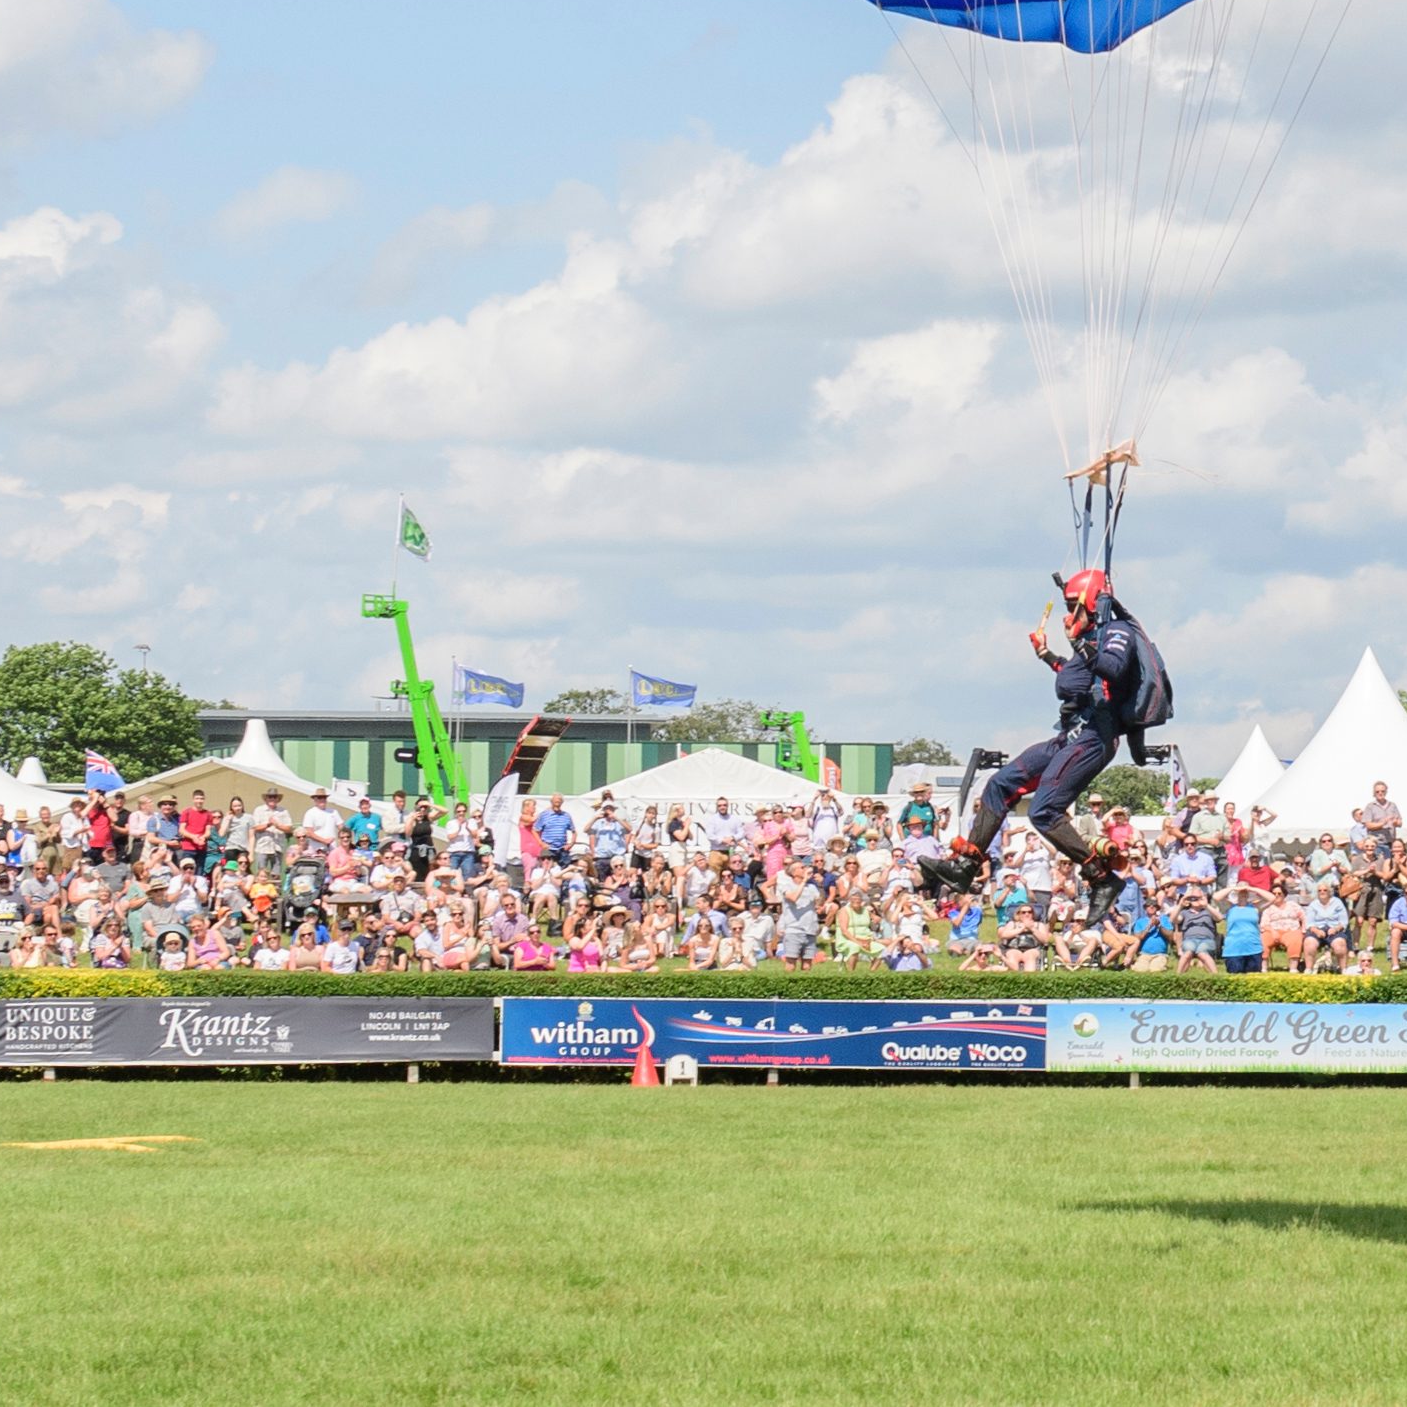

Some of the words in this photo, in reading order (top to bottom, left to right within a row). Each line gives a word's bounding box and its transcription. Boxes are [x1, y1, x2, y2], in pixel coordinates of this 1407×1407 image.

[398, 1010, 442, 1020] BAILGATE
[5, 1026, 94, 1041] BESPOKE
[159, 1008, 273, 1057] Krantz
[360, 1022, 401, 1031] LINCOLN
[531, 1021, 638, 1045] witham
[1130, 1009, 1280, 1045] Emerald
[1285, 1009, 1391, 1056] Green
[192, 1036, 271, 1046] DESIGNS
[558, 1047, 612, 1056] GROUP
[1131, 1047, 1158, 1060] High
[1160, 1047, 1202, 1060] Quality
[1205, 1046, 1237, 1058] Dried
[1239, 1047, 1281, 1060] Forage
[1324, 1047, 1349, 1059] Feed
[1352, 1049, 1366, 1059] as
[1369, 1047, 1407, 1059] Nature
[680, 1060, 686, 1076] 1
